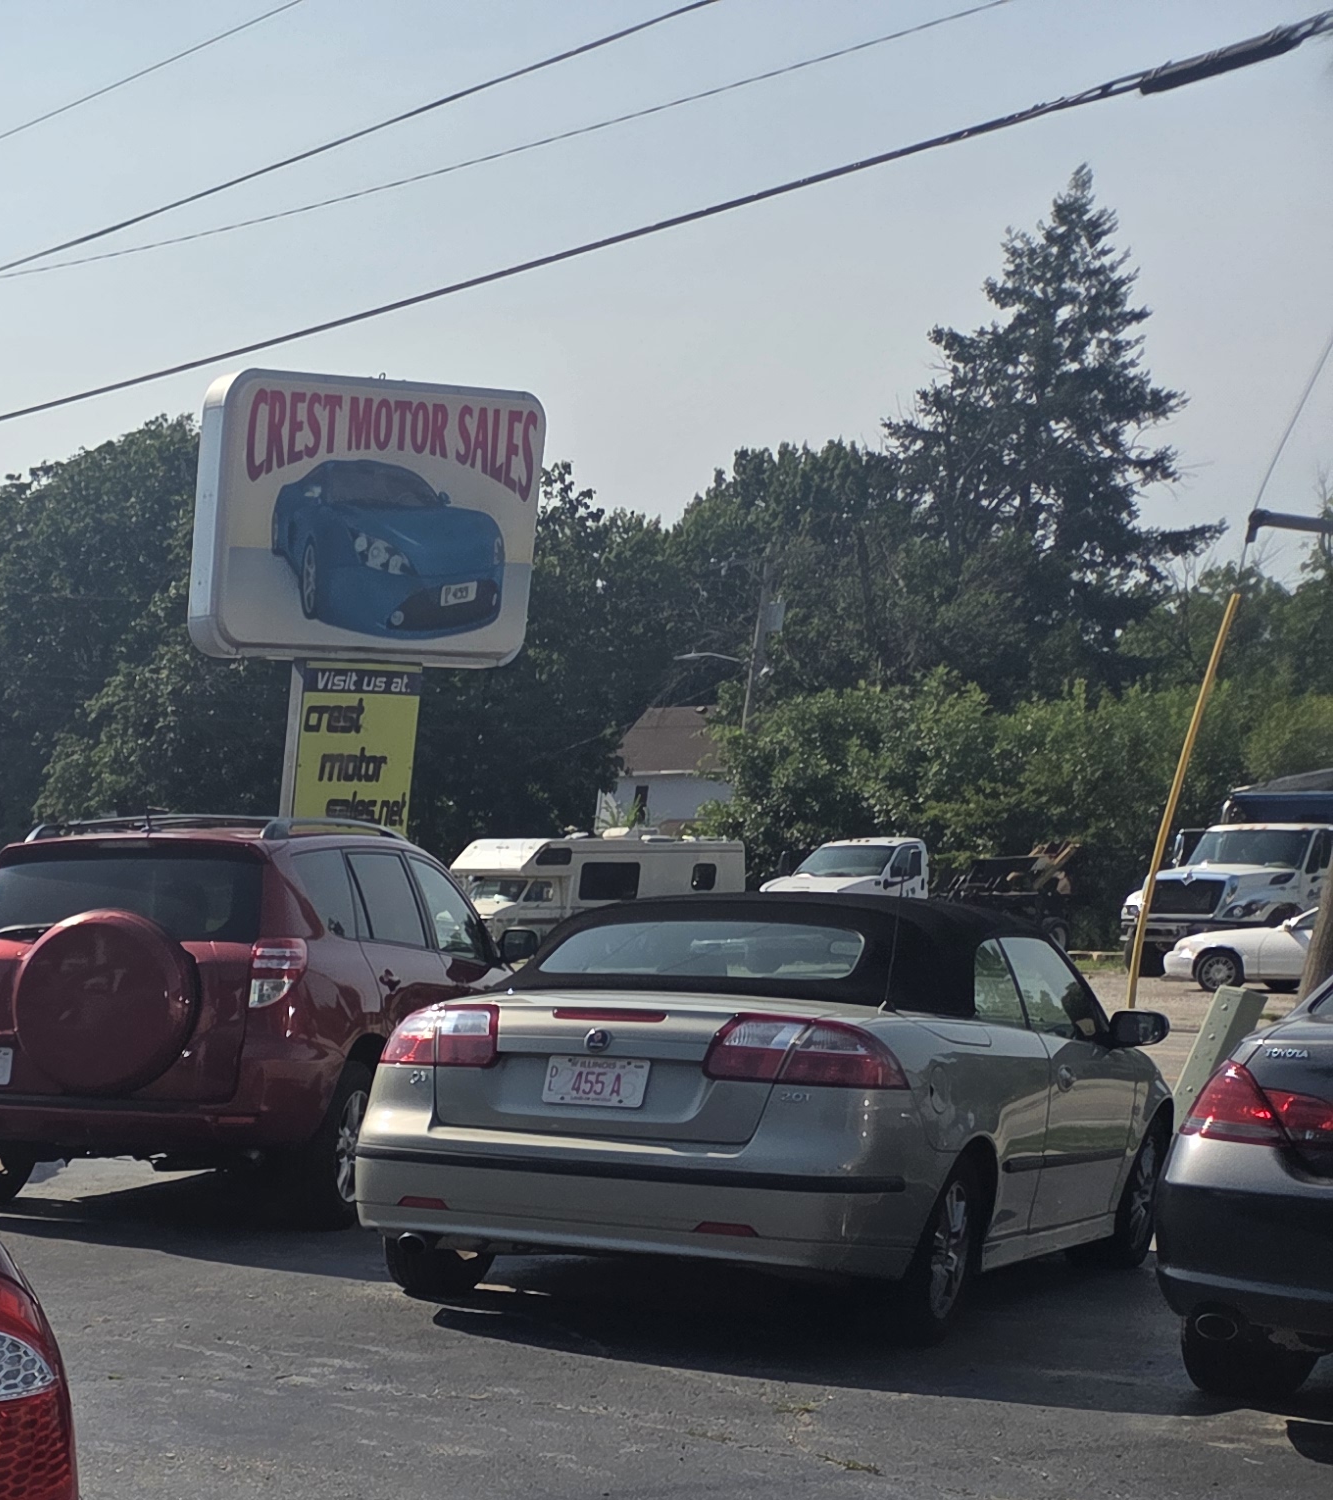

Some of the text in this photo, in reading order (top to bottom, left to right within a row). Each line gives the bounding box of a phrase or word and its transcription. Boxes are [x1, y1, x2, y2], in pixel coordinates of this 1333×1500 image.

[246, 388, 538, 503] CREST MOTOR SALES
[317, 671, 358, 690] Visit
[362, 676, 387, 691] us
[303, 697, 365, 734] crest
[318, 746, 388, 783] motor
[325, 790, 407, 827] sales.net
[1265, 1047, 1309, 1058] TOYOTA
[571, 1071, 622, 1097] 455 A
